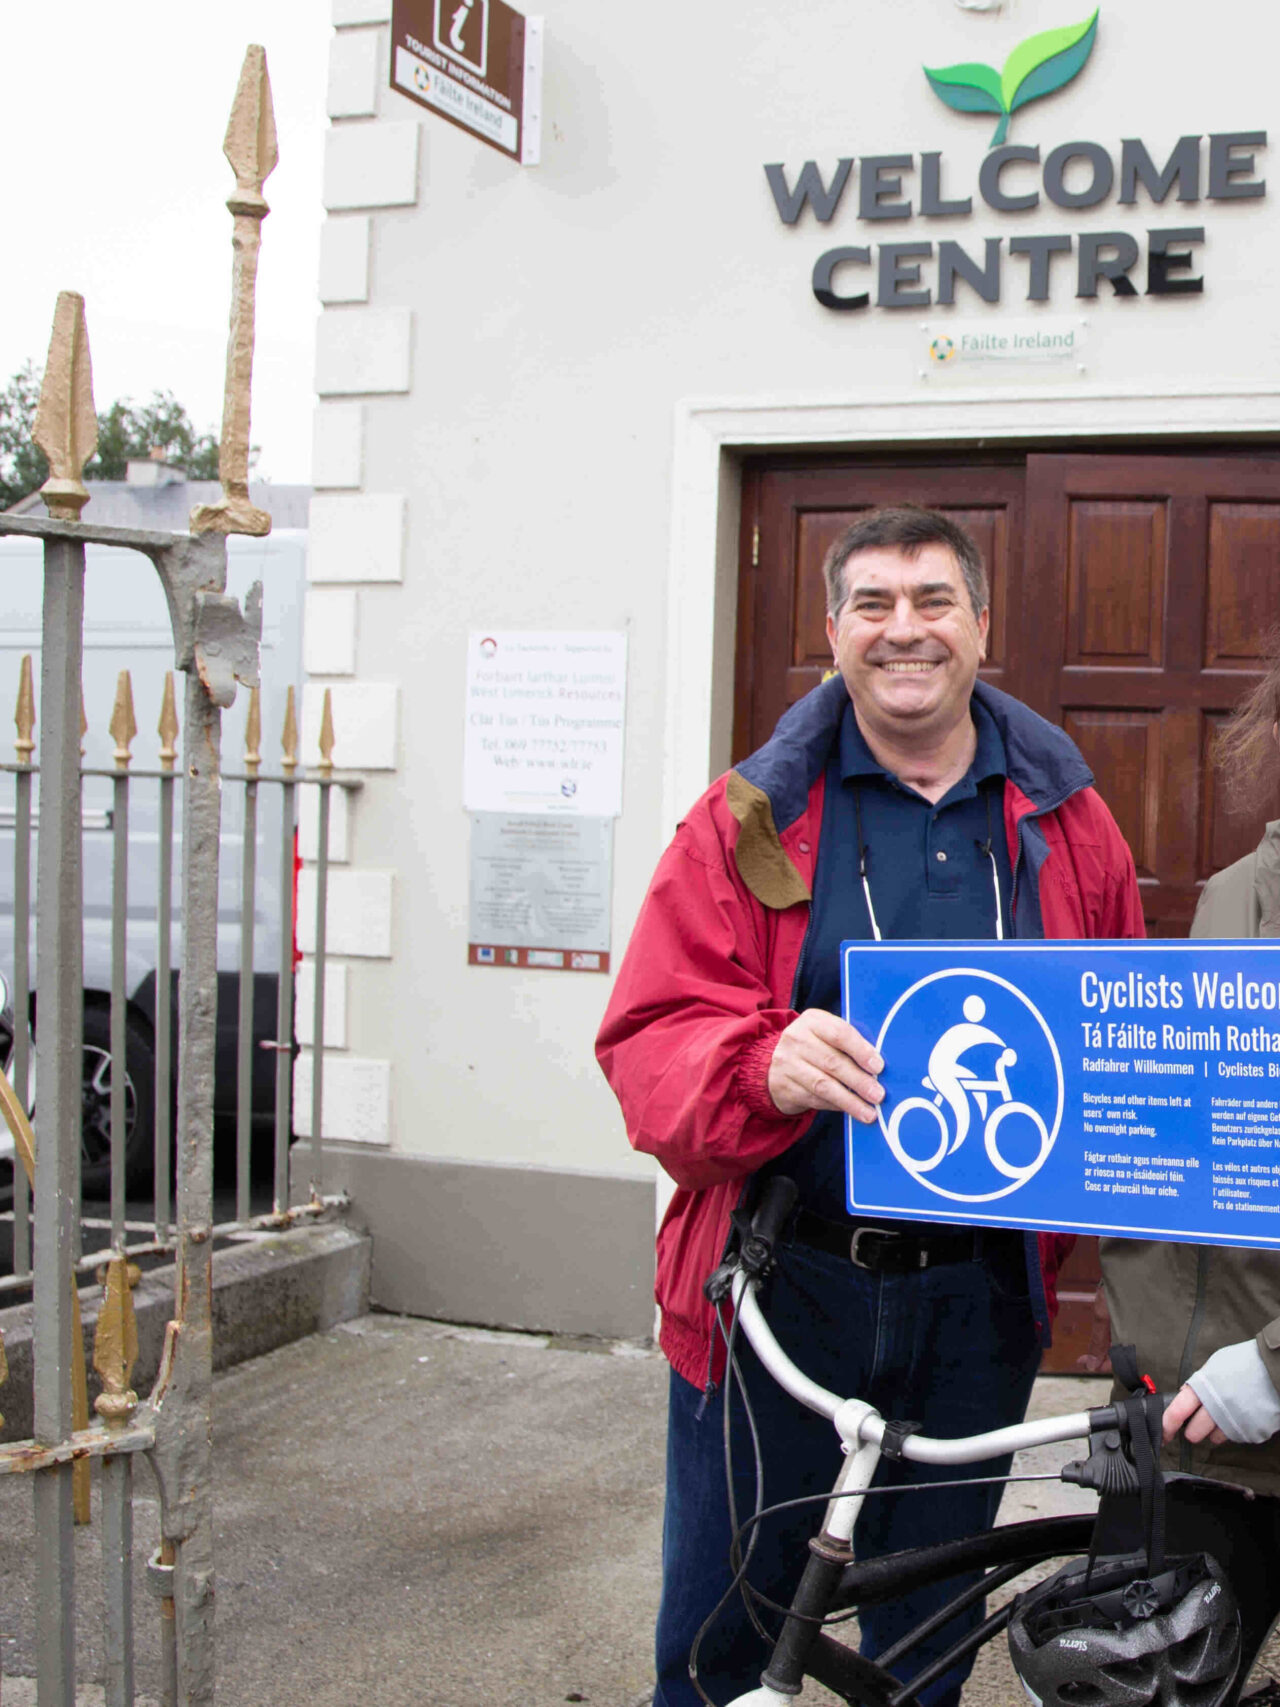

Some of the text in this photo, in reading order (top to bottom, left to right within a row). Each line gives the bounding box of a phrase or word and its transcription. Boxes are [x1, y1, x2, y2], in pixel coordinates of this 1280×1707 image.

[405, 33, 512, 111] TOURIST INFORMATION
[466, 94, 503, 129] Ireland
[763, 131, 1267, 225] WELCOME
[811, 227, 1205, 311] CENTRE
[961, 331, 1075, 350] Fáilte Ireland
[558, 687, 622, 702] Resources
[1080, 971, 1184, 1013] Cyclists
[1081, 1022, 1102, 1048] Tá
[1107, 1022, 1157, 1049] Fáilte
[1162, 1024, 1221, 1051] Roimh
[1082, 1057, 1130, 1073] Radfahrer
[1133, 1059, 1195, 1076] Willkommen
[1218, 1061, 1265, 1078] Cyclistes
[1083, 1092, 1192, 1107] Bicycles and other items left at
[1211, 1097, 1242, 1107] Fahrräder
[1242, 1098, 1255, 1108] und
[1256, 1099, 1278, 1110] andere
[1106, 1110, 1121, 1119] own
[1122, 1109, 1138, 1120] risk.
[1211, 1111, 1235, 1121] werden
[1235, 1111, 1247, 1121] auf
[1247, 1113, 1269, 1122] eigene
[1083, 1122, 1158, 1138] No overnight parking.
[1211, 1123, 1243, 1133] Benutzers
[1212, 1135, 1226, 1145] Kein
[1227, 1136, 1257, 1148] Parkplatz
[1258, 1137, 1273, 1148] über
[1084, 1151, 1107, 1164] Fágtar
[1108, 1153, 1132, 1164] rothair
[1133, 1156, 1150, 1166] agus
[1186, 1157, 1200, 1168] eile
[1084, 1167, 1092, 1176] ar
[1116, 1170, 1125, 1179] na
[1212, 1161, 1224, 1171] Les
[1224, 1162, 1241, 1172] vélos
[1241, 1163, 1249, 1173] et
[1250, 1164, 1271, 1174] autres
[1085, 1180, 1102, 1192] Cosc
[1103, 1183, 1111, 1192] ar
[1141, 1184, 1157, 1195] thar
[1212, 1174, 1234, 1185] laissés
[1235, 1177, 1247, 1185] aux
[1247, 1176, 1271, 1188] risques
[1272, 1178, 1279, 1187] et
[1213, 1200, 1225, 1210] Pas
[1226, 1201, 1234, 1210] de
[1235, 1202, 1280, 1214] stationnement
[1059, 1639, 1088, 1651] Sierra
